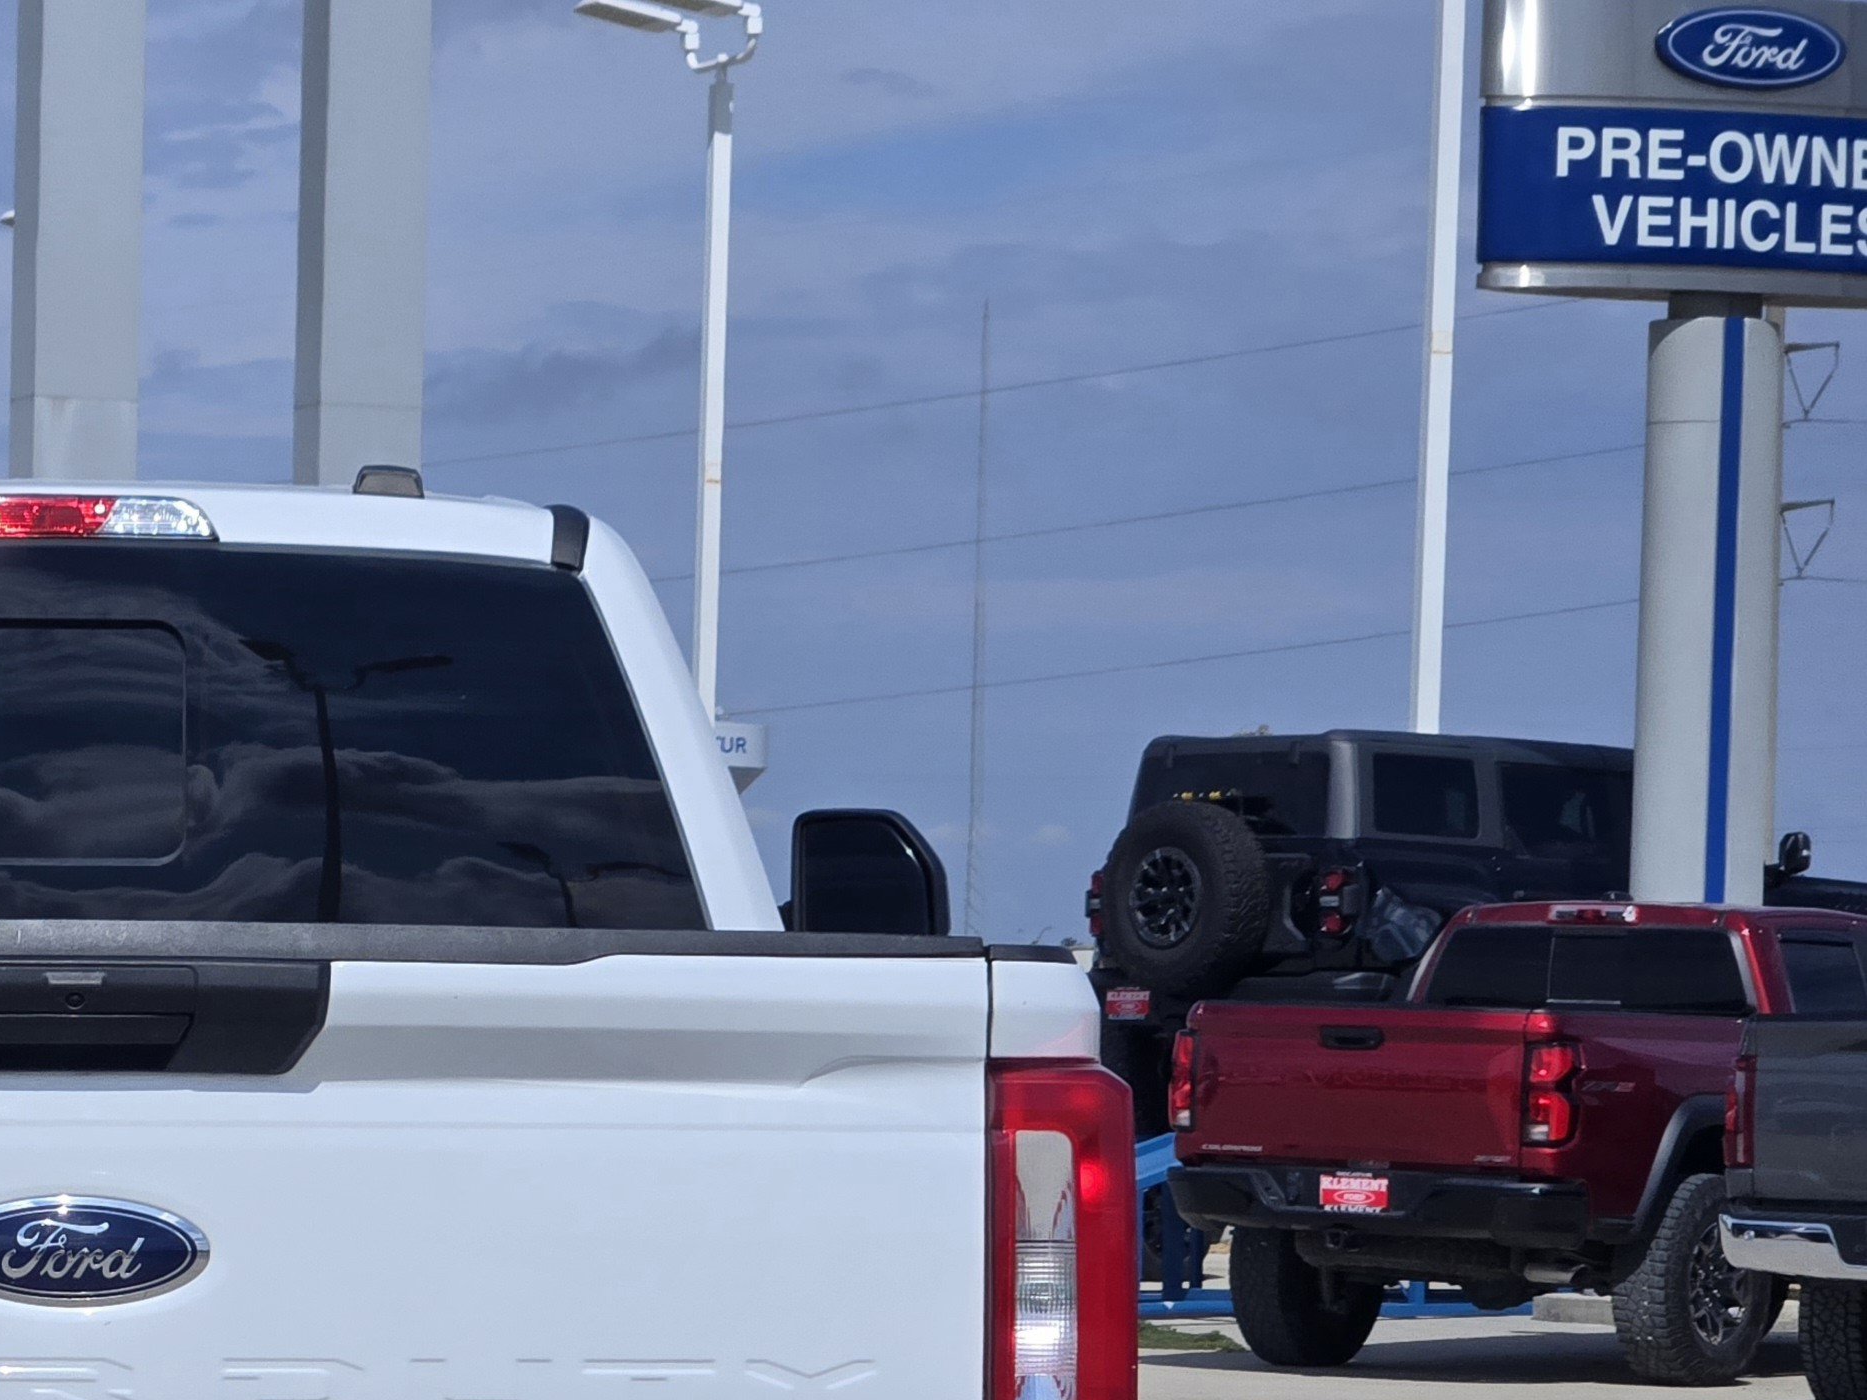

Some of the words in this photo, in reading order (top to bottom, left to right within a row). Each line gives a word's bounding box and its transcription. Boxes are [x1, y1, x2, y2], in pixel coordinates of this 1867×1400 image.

[1701, 23, 1809, 71] Ford
[1591, 194, 1867, 257] VEHICLE
[1, 1218, 145, 1282] Ford
